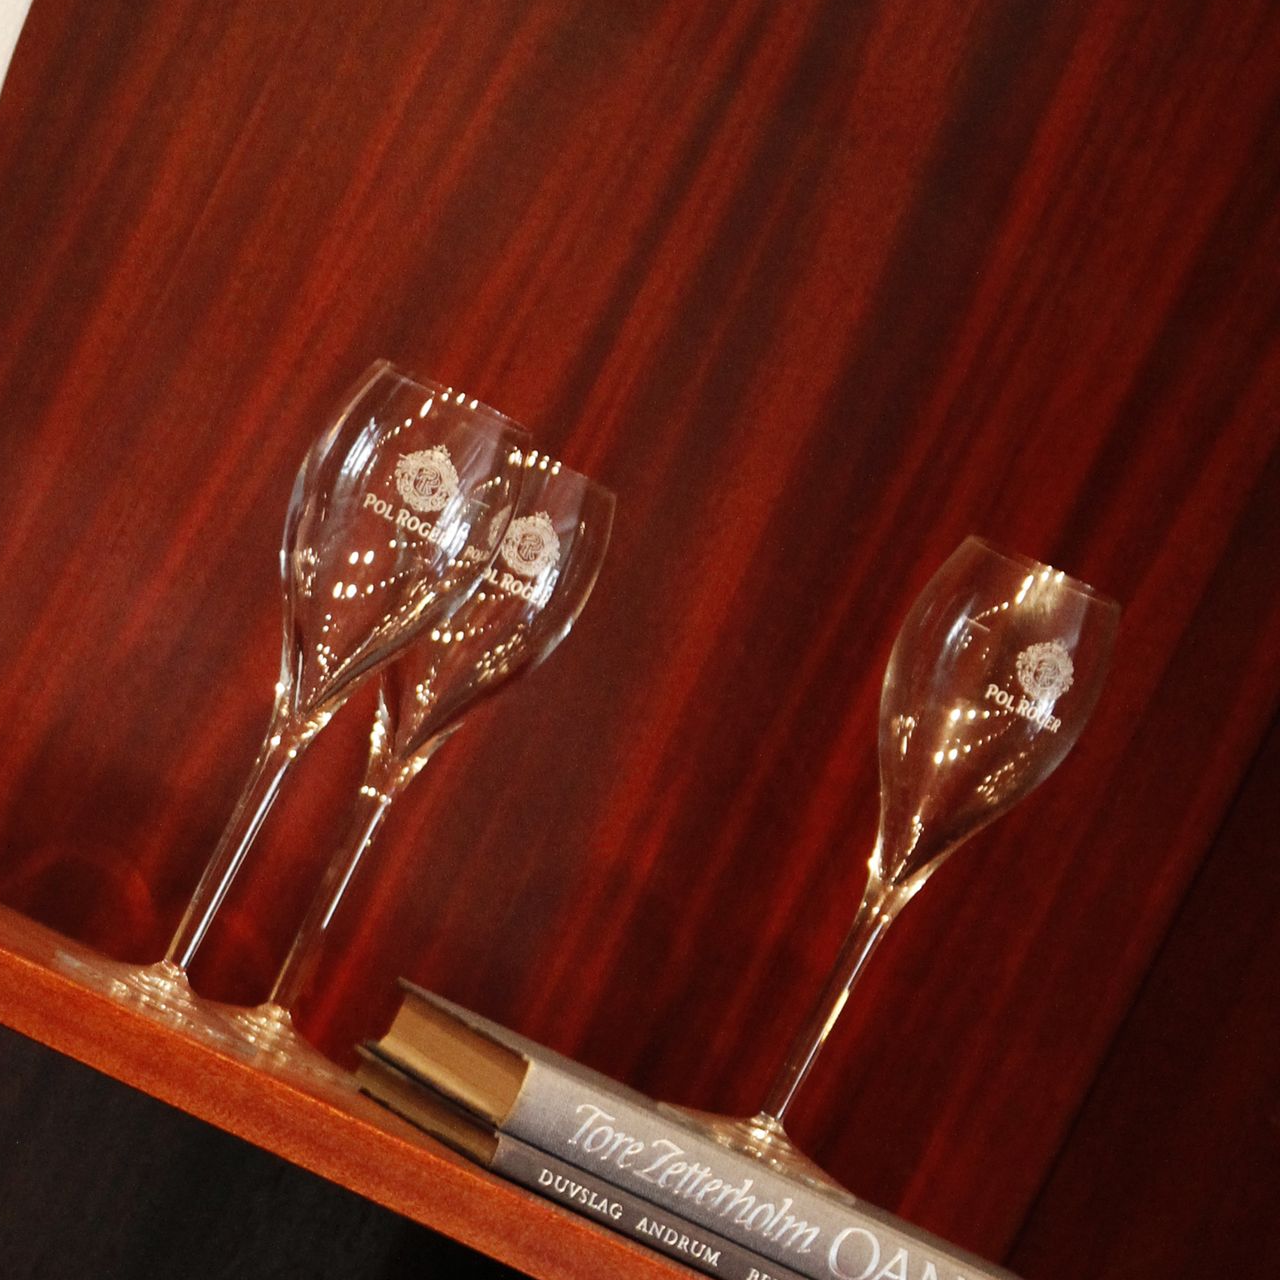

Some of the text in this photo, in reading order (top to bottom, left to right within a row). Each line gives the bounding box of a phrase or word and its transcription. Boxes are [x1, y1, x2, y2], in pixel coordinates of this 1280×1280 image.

[363, 493, 450, 546] POL ROGE
[985, 683, 1014, 713] POL
[568, 1104, 820, 1253] Tore Zetterholm
[538, 1169, 723, 1267] DUVSLAG ANDRUM
